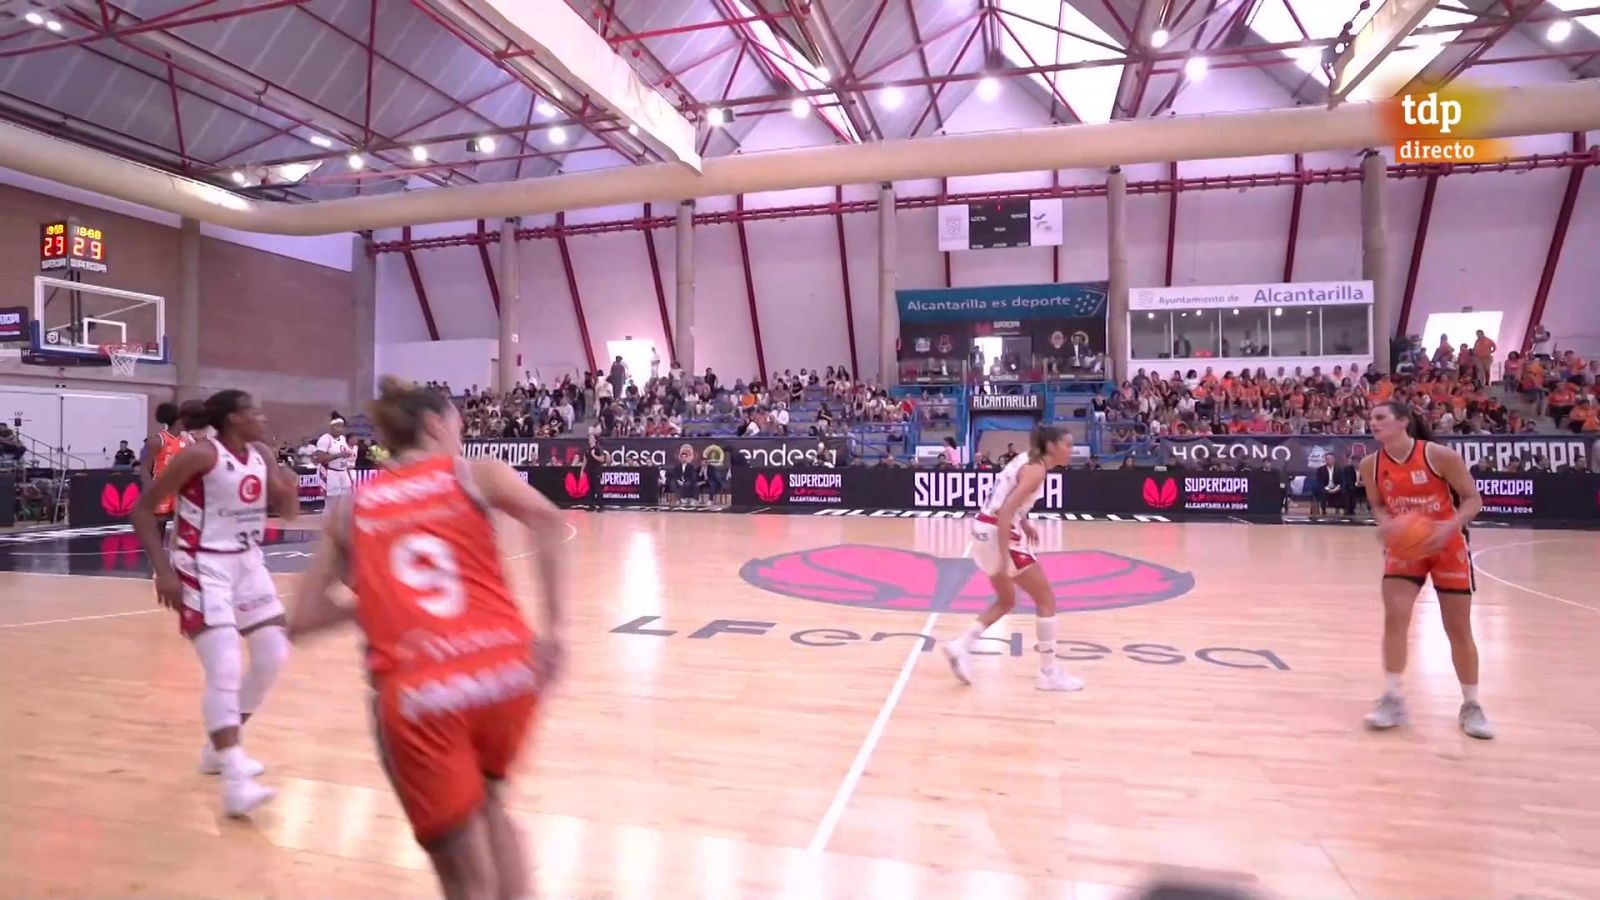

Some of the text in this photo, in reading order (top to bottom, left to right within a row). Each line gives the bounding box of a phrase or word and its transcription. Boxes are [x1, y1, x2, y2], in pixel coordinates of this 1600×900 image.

[1158, 295, 1225, 305] Ayuntamiento
[1253, 286, 1365, 304] Alcantarilla
[907, 299, 988, 311] Alcantarilla
[1011, 296, 1071, 308] deporte
[973, 395, 1037, 408] ALCANTARILLA
[463, 443, 539, 466] UPERCOPA
[600, 472, 640, 485] UPERCOPA
[789, 474, 842, 488] SUPERCOPA
[1184, 478, 1249, 493] SUPERCOPA
[914, 472, 1062, 508] SUPERA
[1474, 479, 1533, 495] PERCOPA
[389, 533, 467, 618] 9
